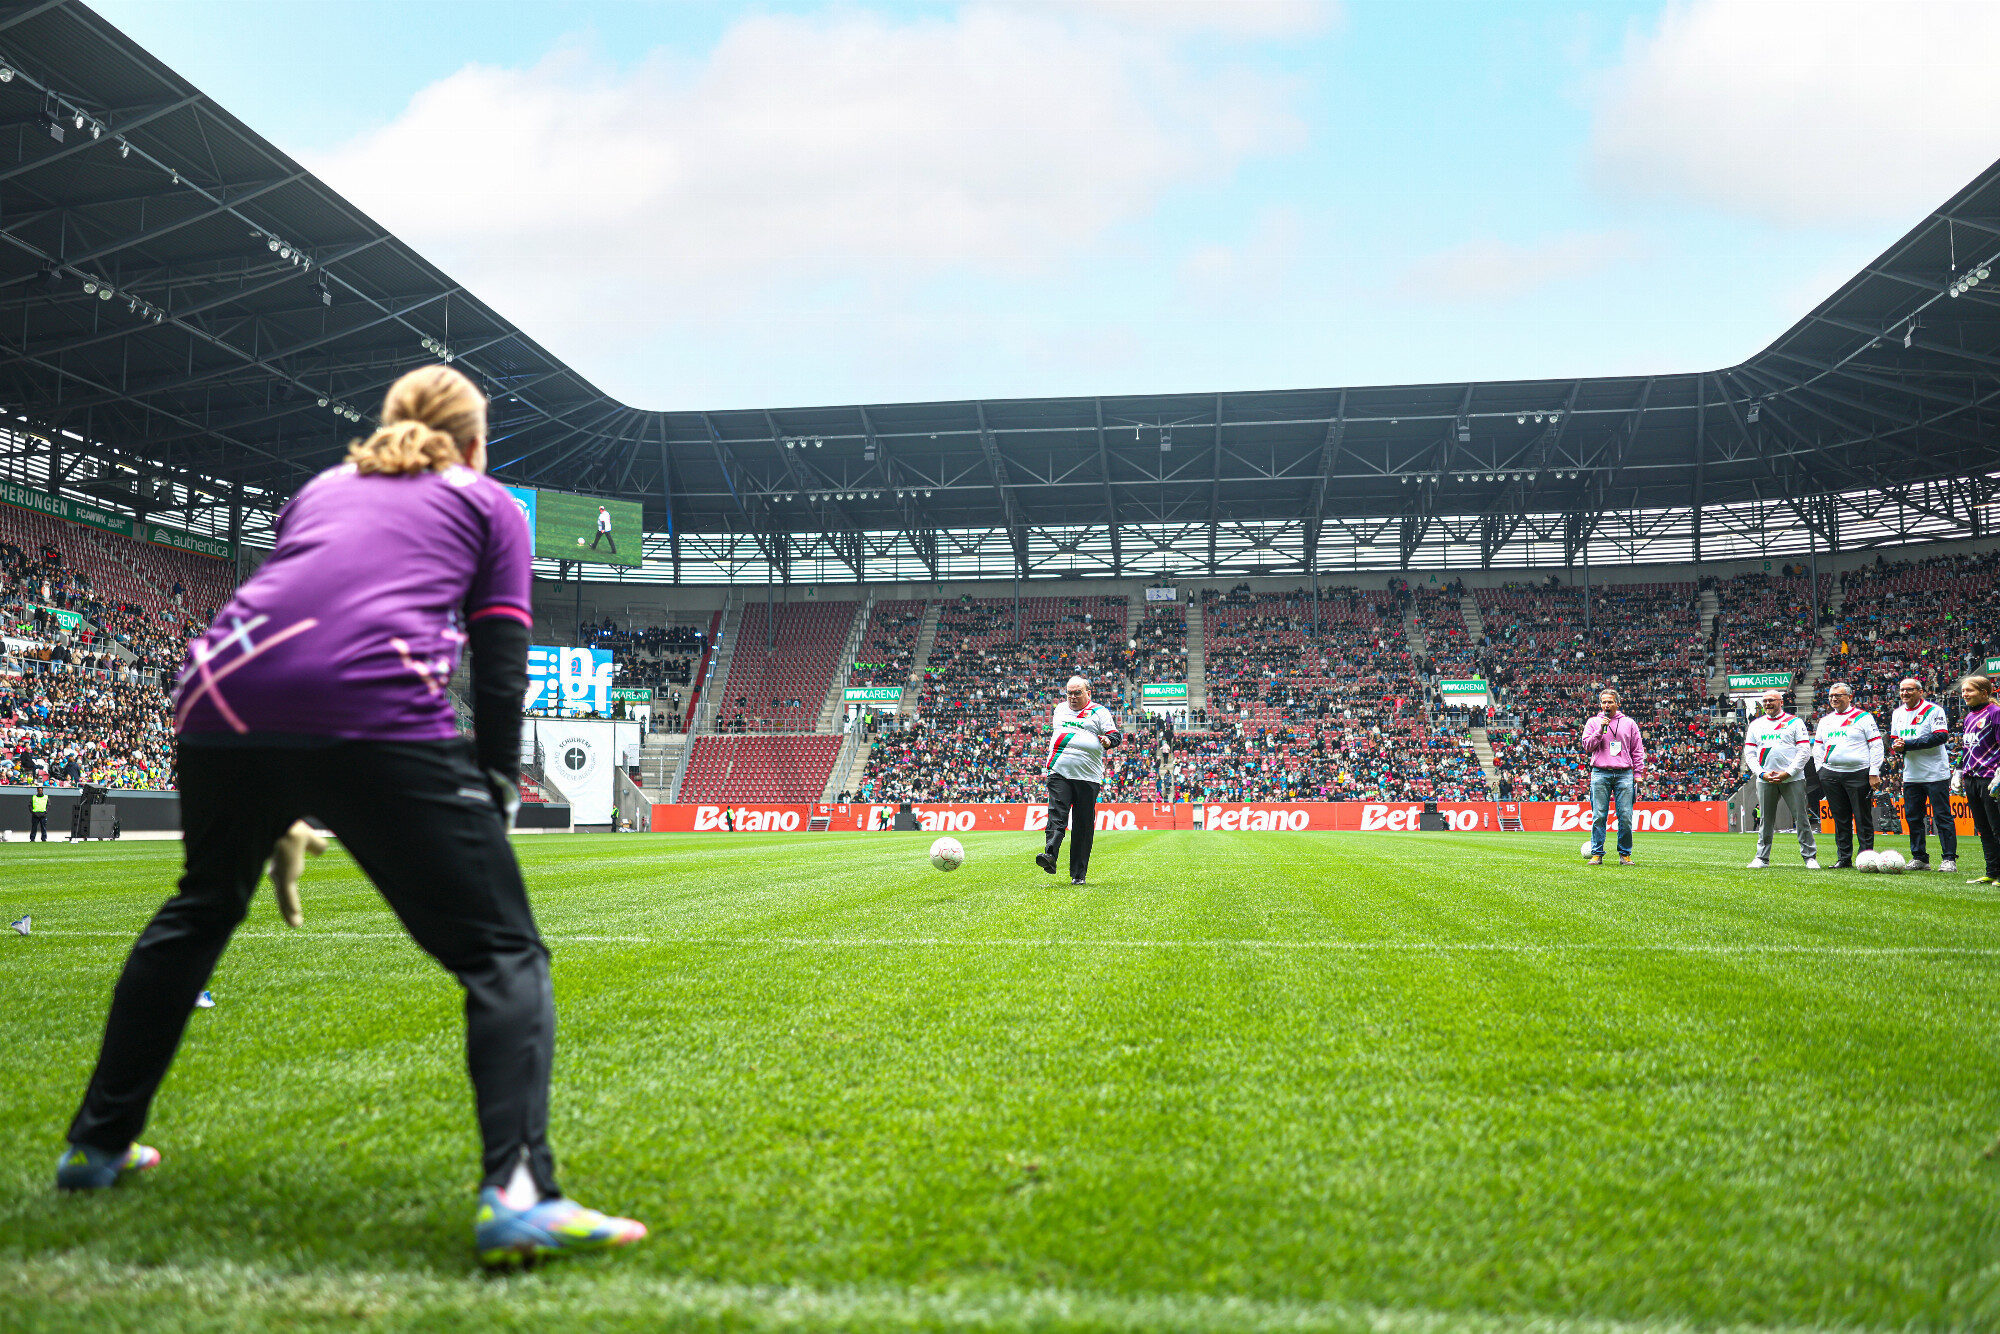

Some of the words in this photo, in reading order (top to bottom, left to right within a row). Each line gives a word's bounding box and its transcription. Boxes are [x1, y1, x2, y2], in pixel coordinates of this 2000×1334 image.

[173, 535, 229, 558] authentica
[1764, 561, 1771, 571] B
[1430, 574, 1437, 583] A
[553, 584, 562, 593] W
[808, 587, 815, 597] X
[937, 585, 944, 593] Y
[1506, 804, 1516, 812] 15
[694, 805, 800, 831] Betano
[1206, 805, 1310, 831] Betano
[1360, 804, 1479, 831] Betno
